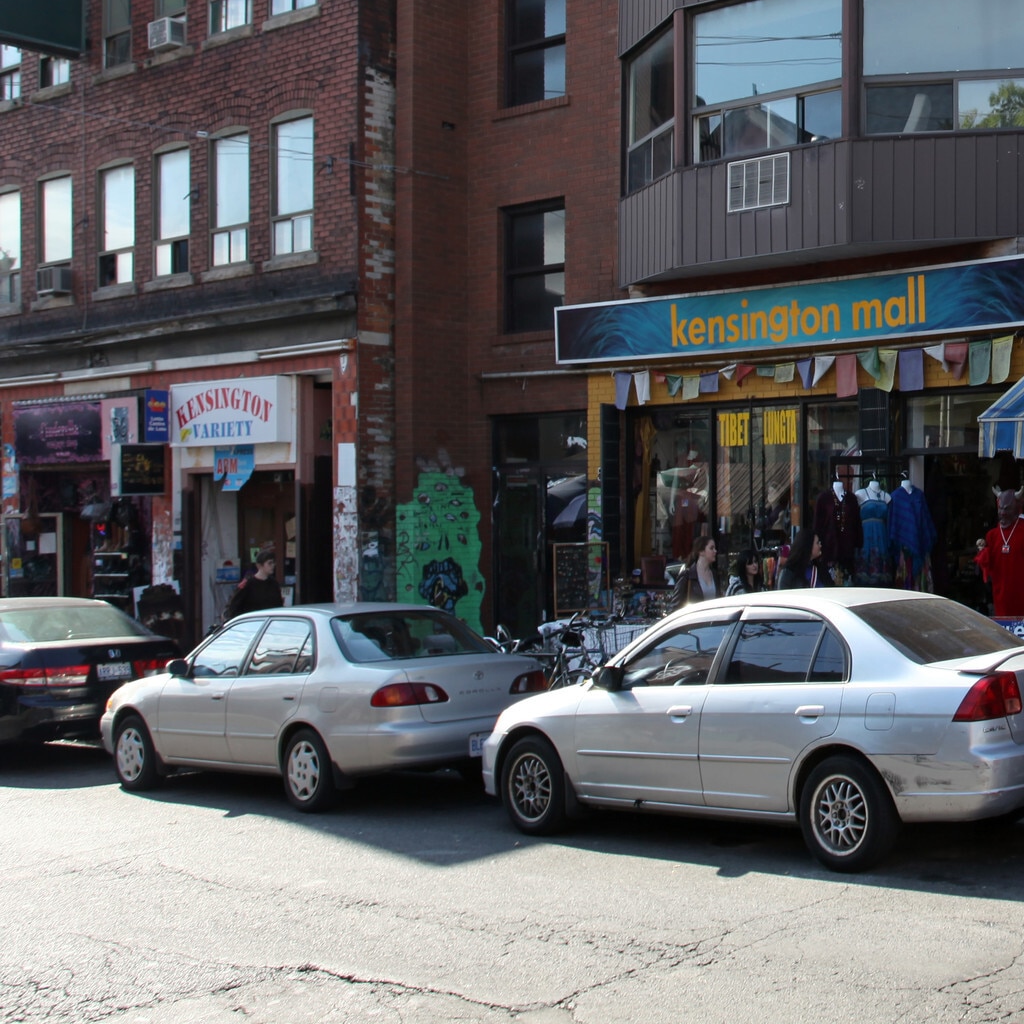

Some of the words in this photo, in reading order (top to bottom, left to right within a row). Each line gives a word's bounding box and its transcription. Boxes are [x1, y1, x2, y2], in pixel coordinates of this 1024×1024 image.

[670, 298, 841, 347] kensington
[852, 275, 926, 330] mall
[175, 387, 273, 429] KENSINGTON
[718, 412, 750, 447] TIBET
[763, 409, 797, 445] LUNGTA
[192, 420, 253, 439] VARIETY
